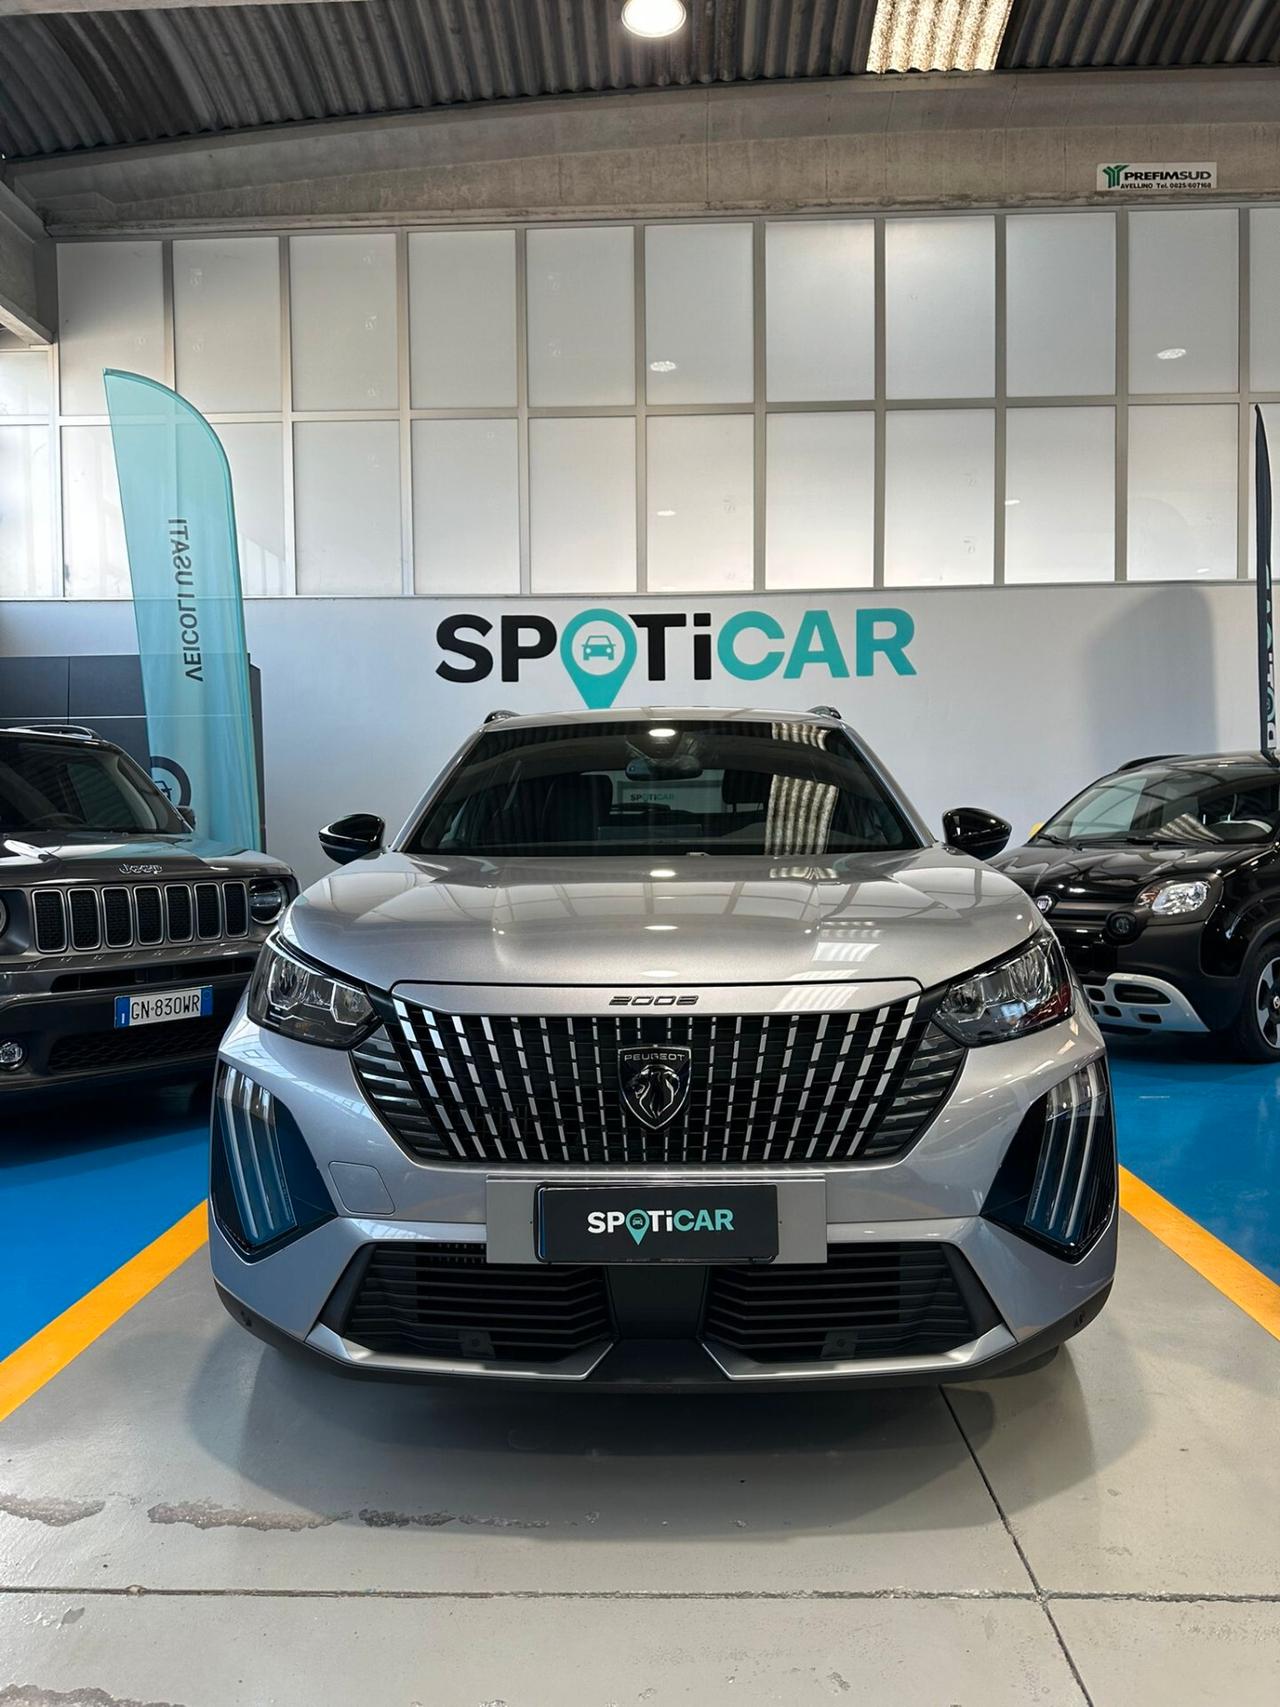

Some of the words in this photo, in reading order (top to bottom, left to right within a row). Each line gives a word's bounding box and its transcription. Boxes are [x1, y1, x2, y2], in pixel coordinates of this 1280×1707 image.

[1124, 171, 1212, 181] PREFIMSUD
[119, 863, 163, 874] Jeep
[608, 995, 699, 1006] 2008
[624, 1052, 686, 1062] PEUGEOT
